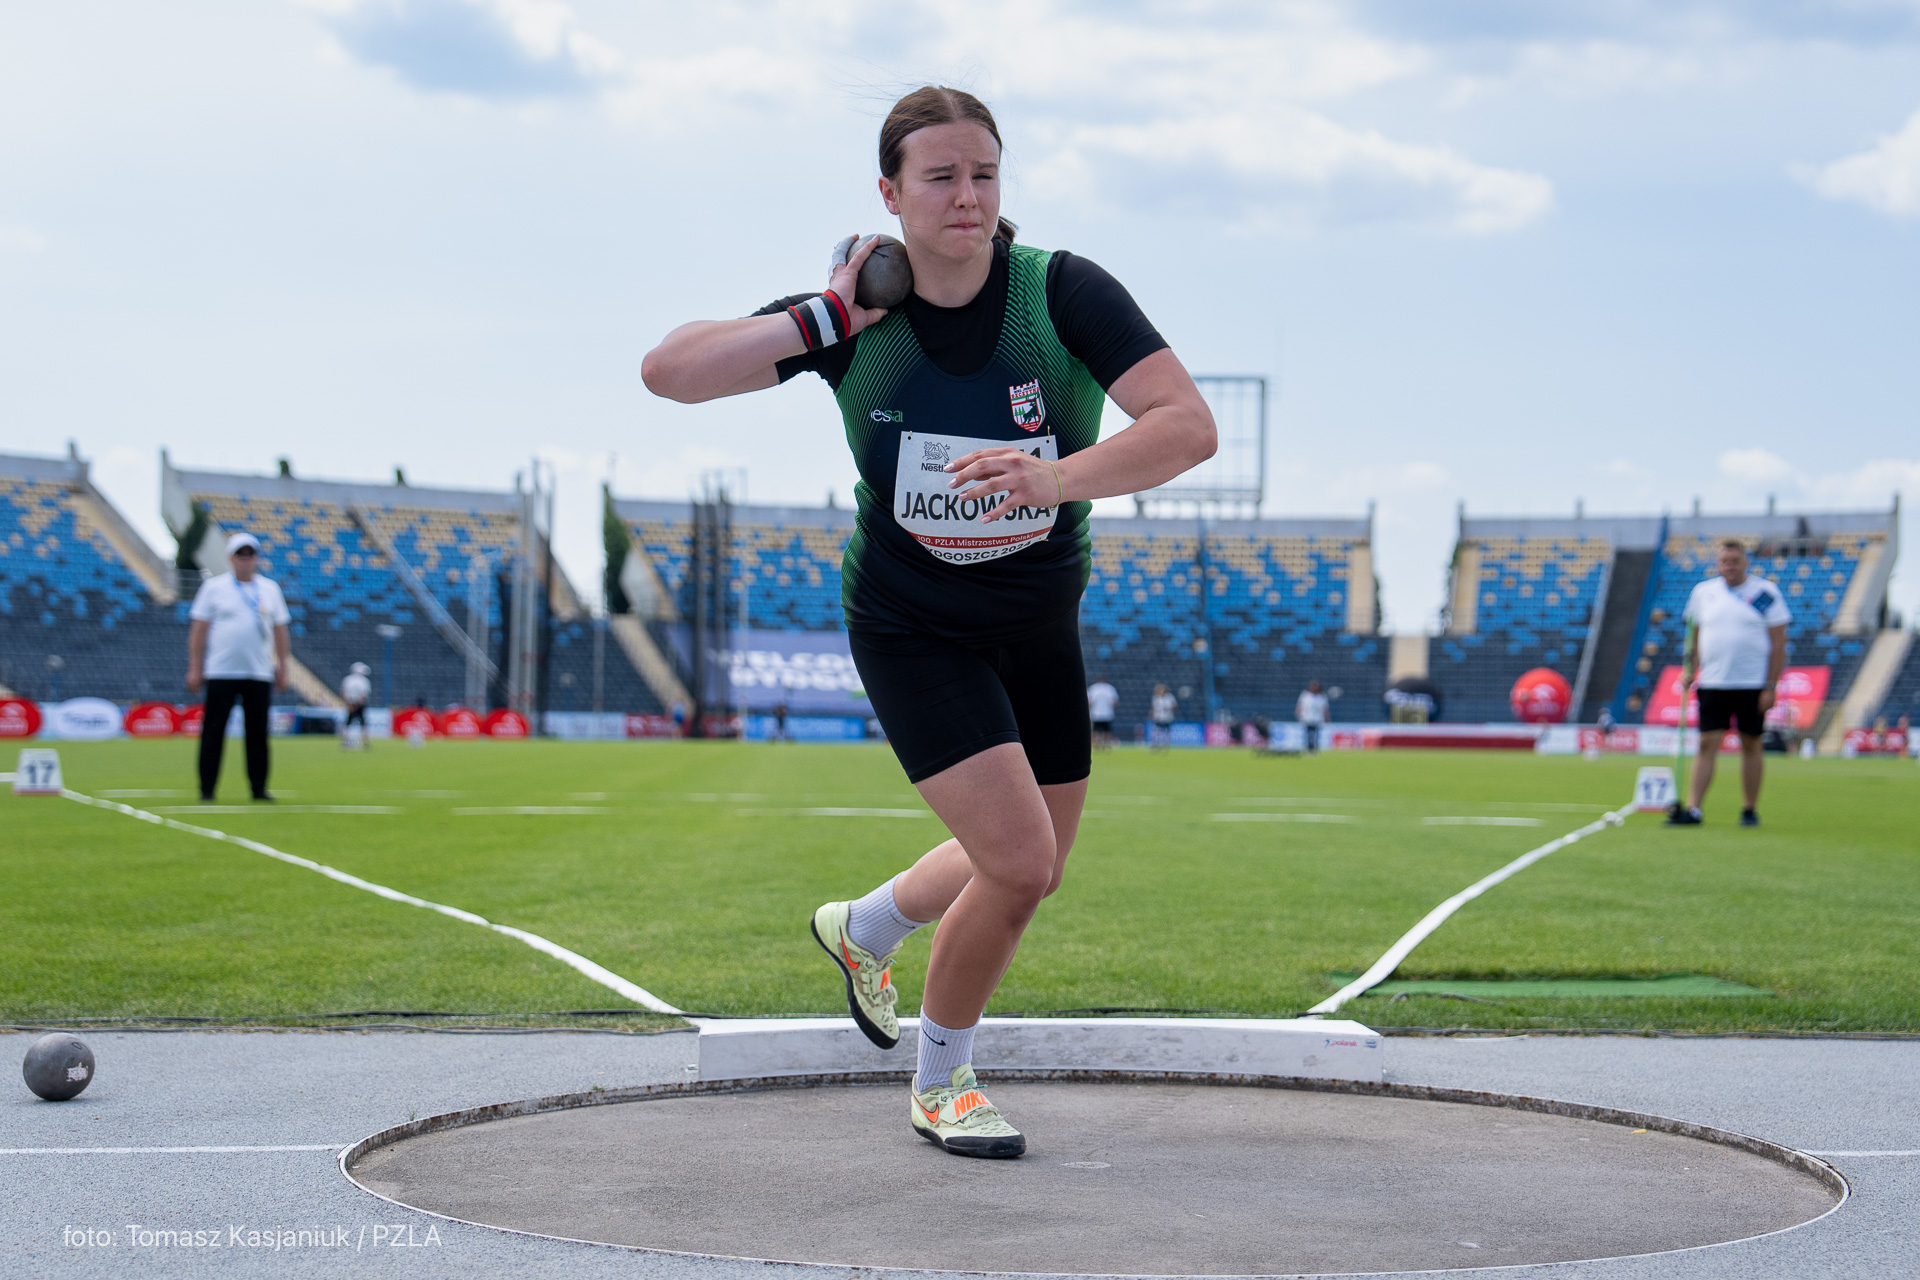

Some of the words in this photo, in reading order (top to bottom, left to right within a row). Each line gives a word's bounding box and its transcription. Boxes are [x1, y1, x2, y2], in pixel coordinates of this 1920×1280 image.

[921, 462, 946, 472] Nestl
[935, 538, 955, 547] PZLA
[957, 538, 1009, 547] Mistrzostwa
[1010, 533, 1034, 543] Polski
[1002, 540, 1032, 555] 2024
[25, 759, 55, 786] 17
[1639, 777, 1668, 803] 17
